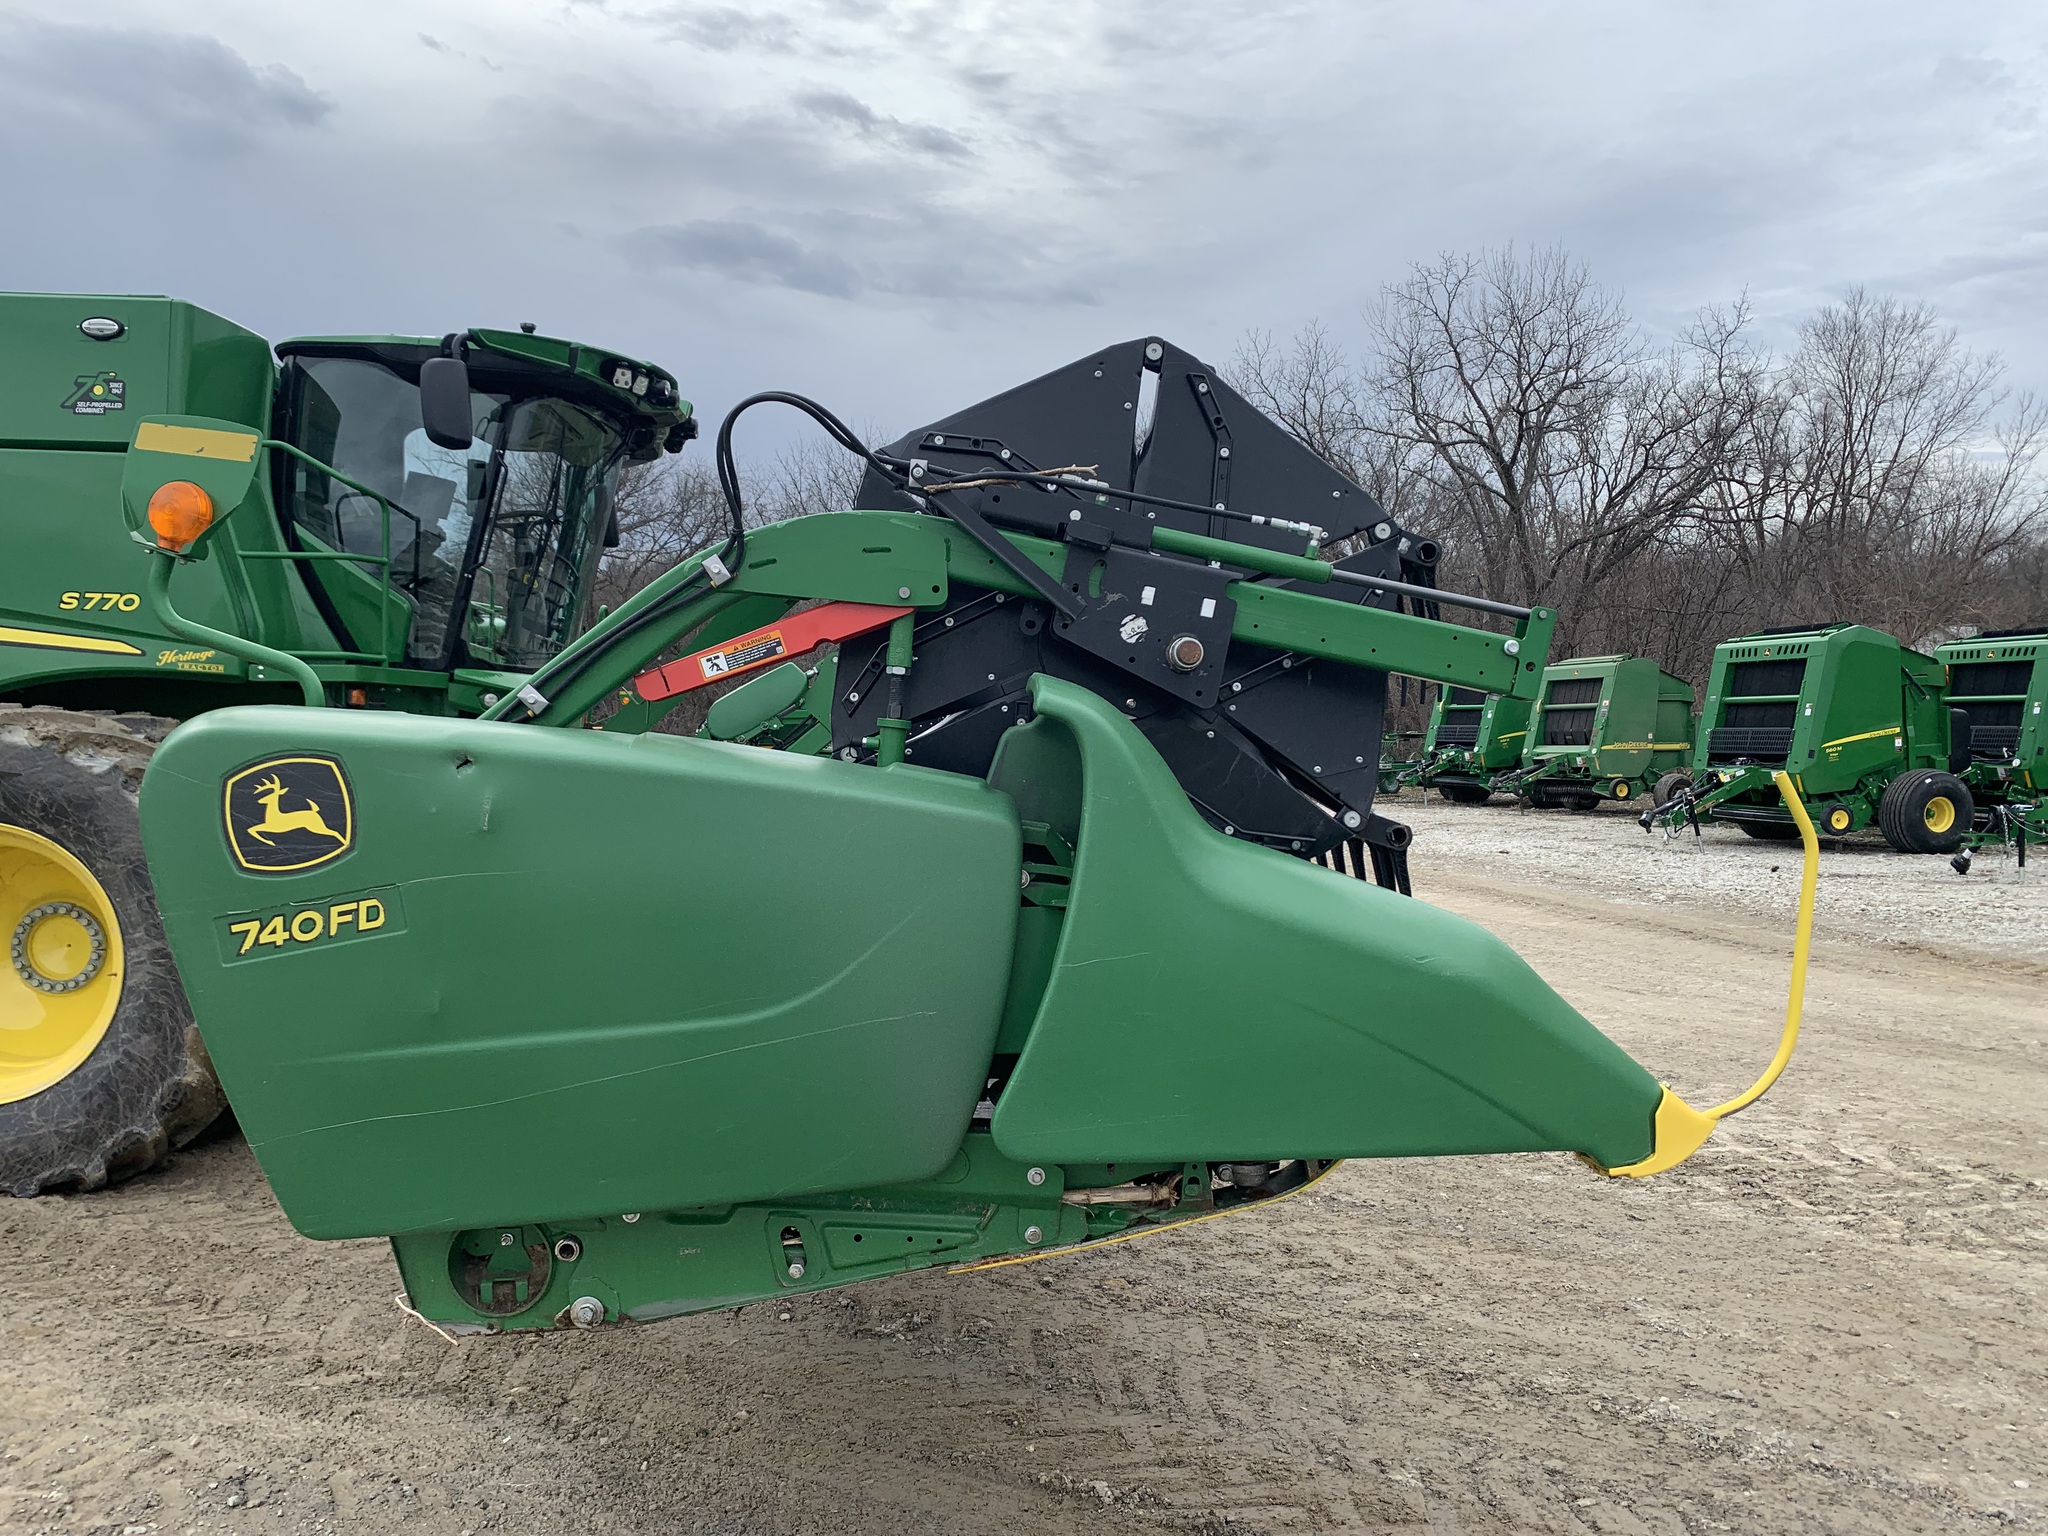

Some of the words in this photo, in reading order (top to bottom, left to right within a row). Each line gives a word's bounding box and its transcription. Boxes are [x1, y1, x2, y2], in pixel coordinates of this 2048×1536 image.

[76, 401, 123, 409] SELF-PROPELLED
[740, 634, 772, 649] WARNING
[156, 650, 216, 667] Heritage
[178, 662, 224, 673] TRACTOR
